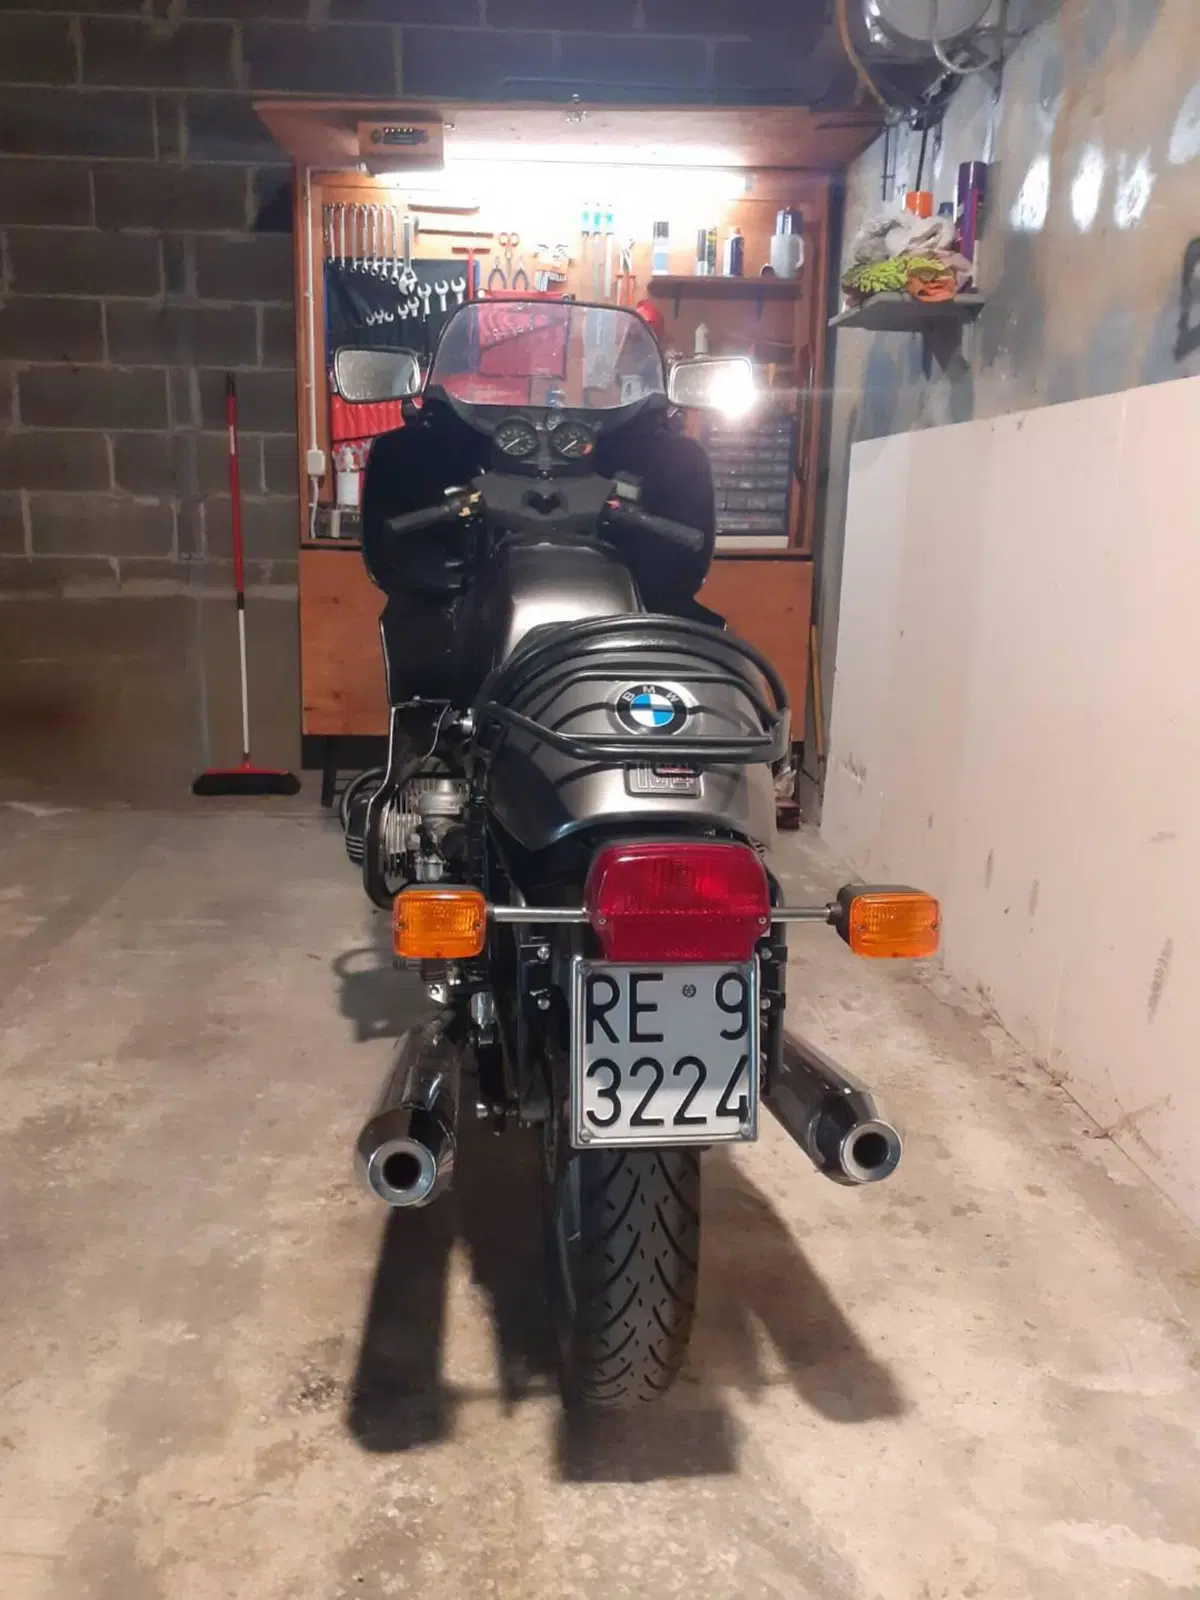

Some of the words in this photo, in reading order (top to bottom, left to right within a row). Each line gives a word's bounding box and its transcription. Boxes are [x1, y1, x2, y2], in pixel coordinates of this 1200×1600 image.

[621, 684, 680, 703] BMW
[585, 972, 664, 1044] RE
[715, 972, 749, 1041] 9
[585, 1054, 750, 1128] 3224
